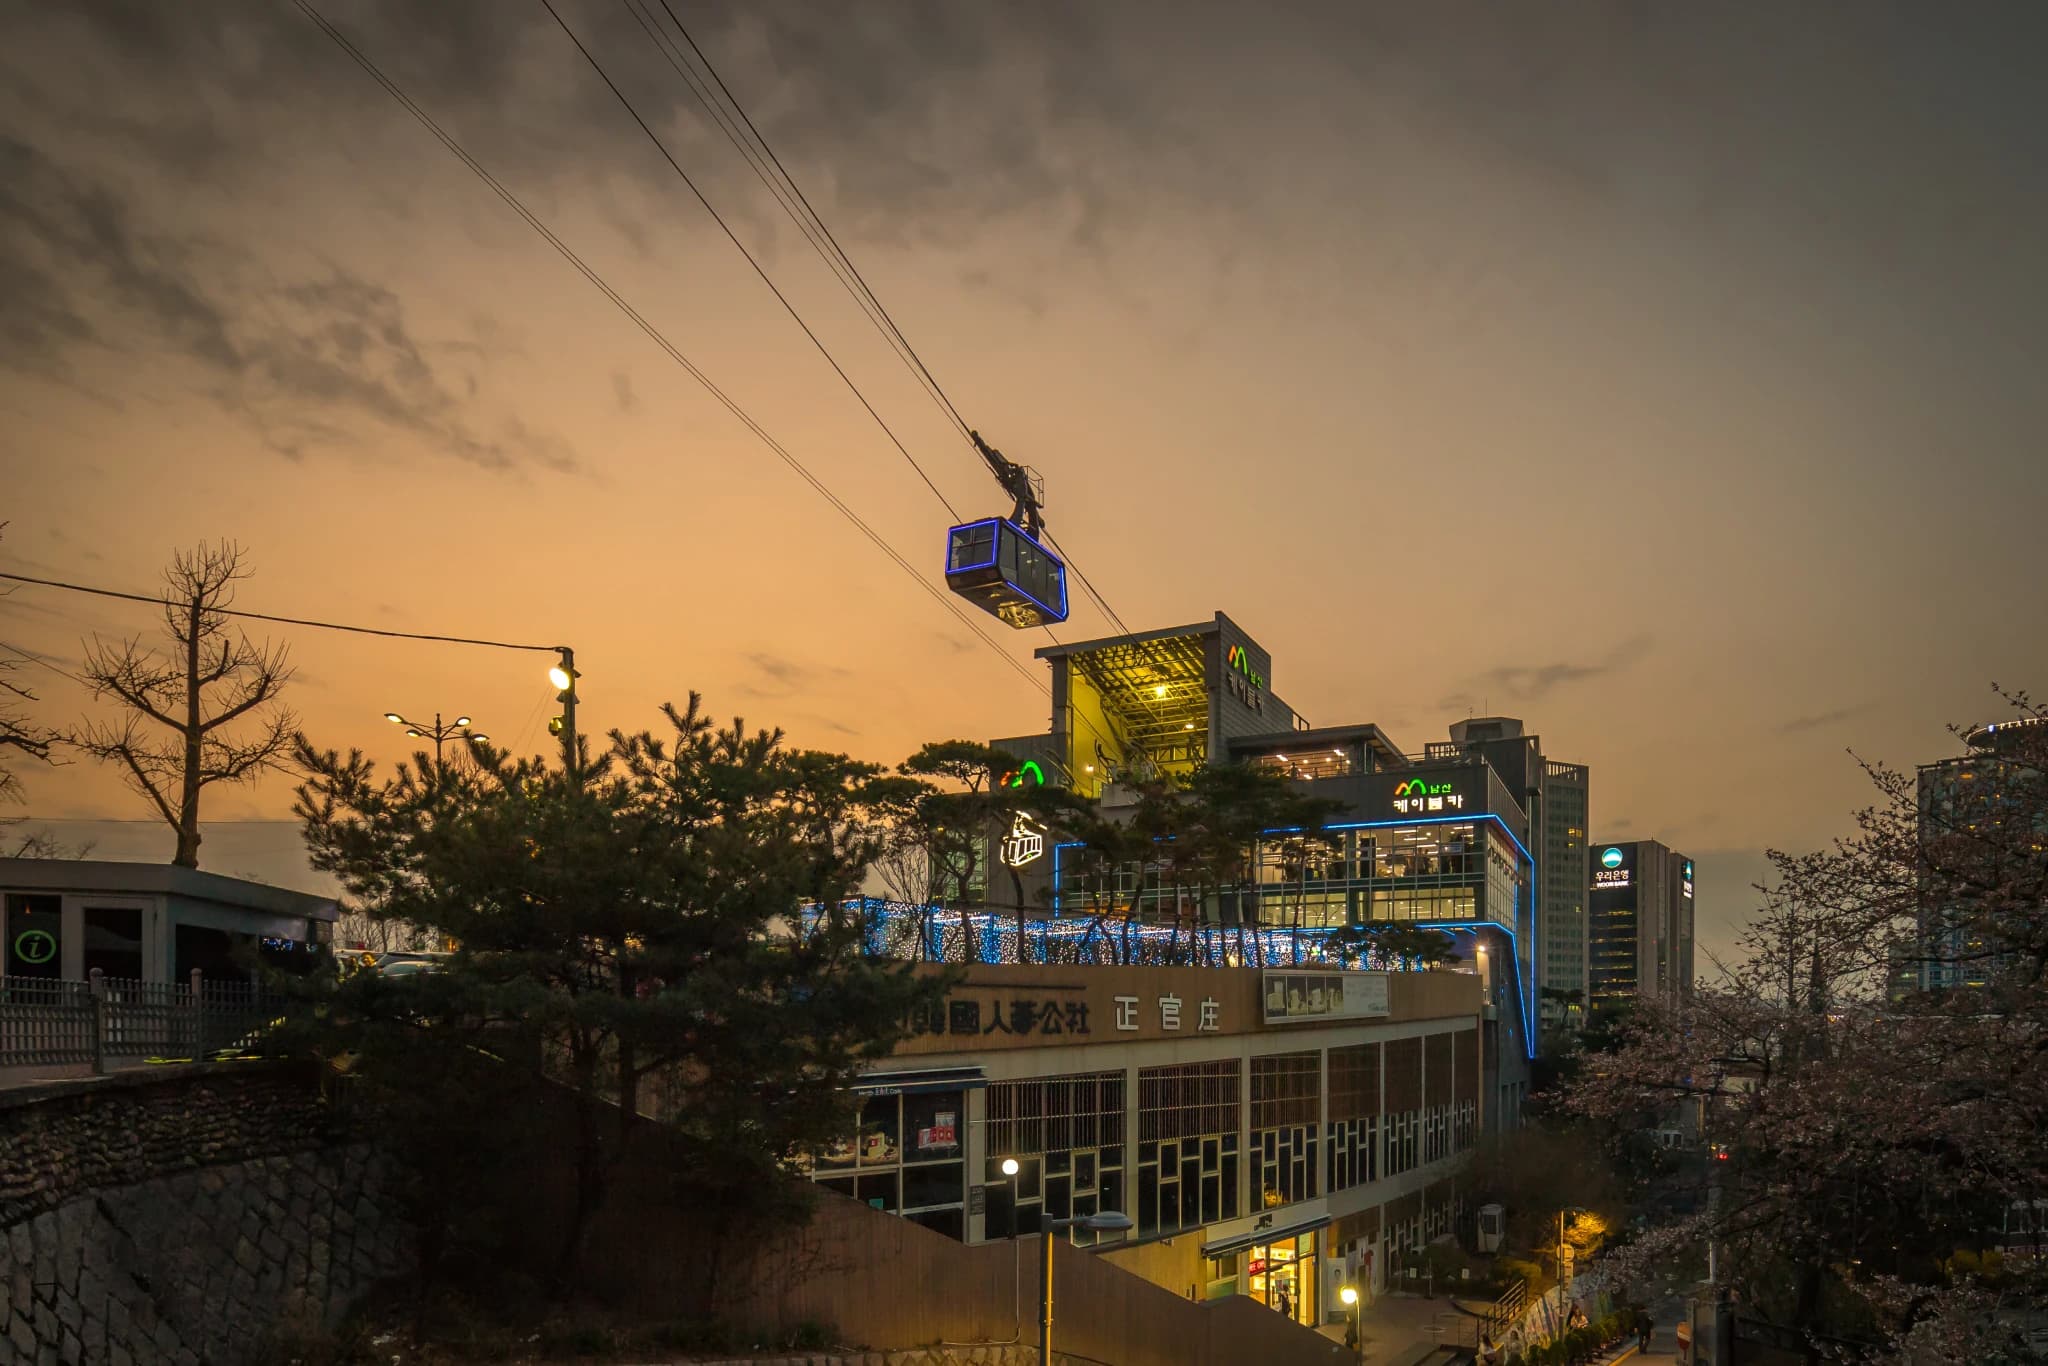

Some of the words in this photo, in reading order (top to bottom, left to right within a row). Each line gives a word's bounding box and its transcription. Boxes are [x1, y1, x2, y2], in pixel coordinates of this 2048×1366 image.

[1430, 783, 1452, 794] 남산
[1393, 794, 1463, 813] 케이블카
[1596, 870, 1629, 881] 우리은행
[1114, 992, 1220, 1031] 正官庄
